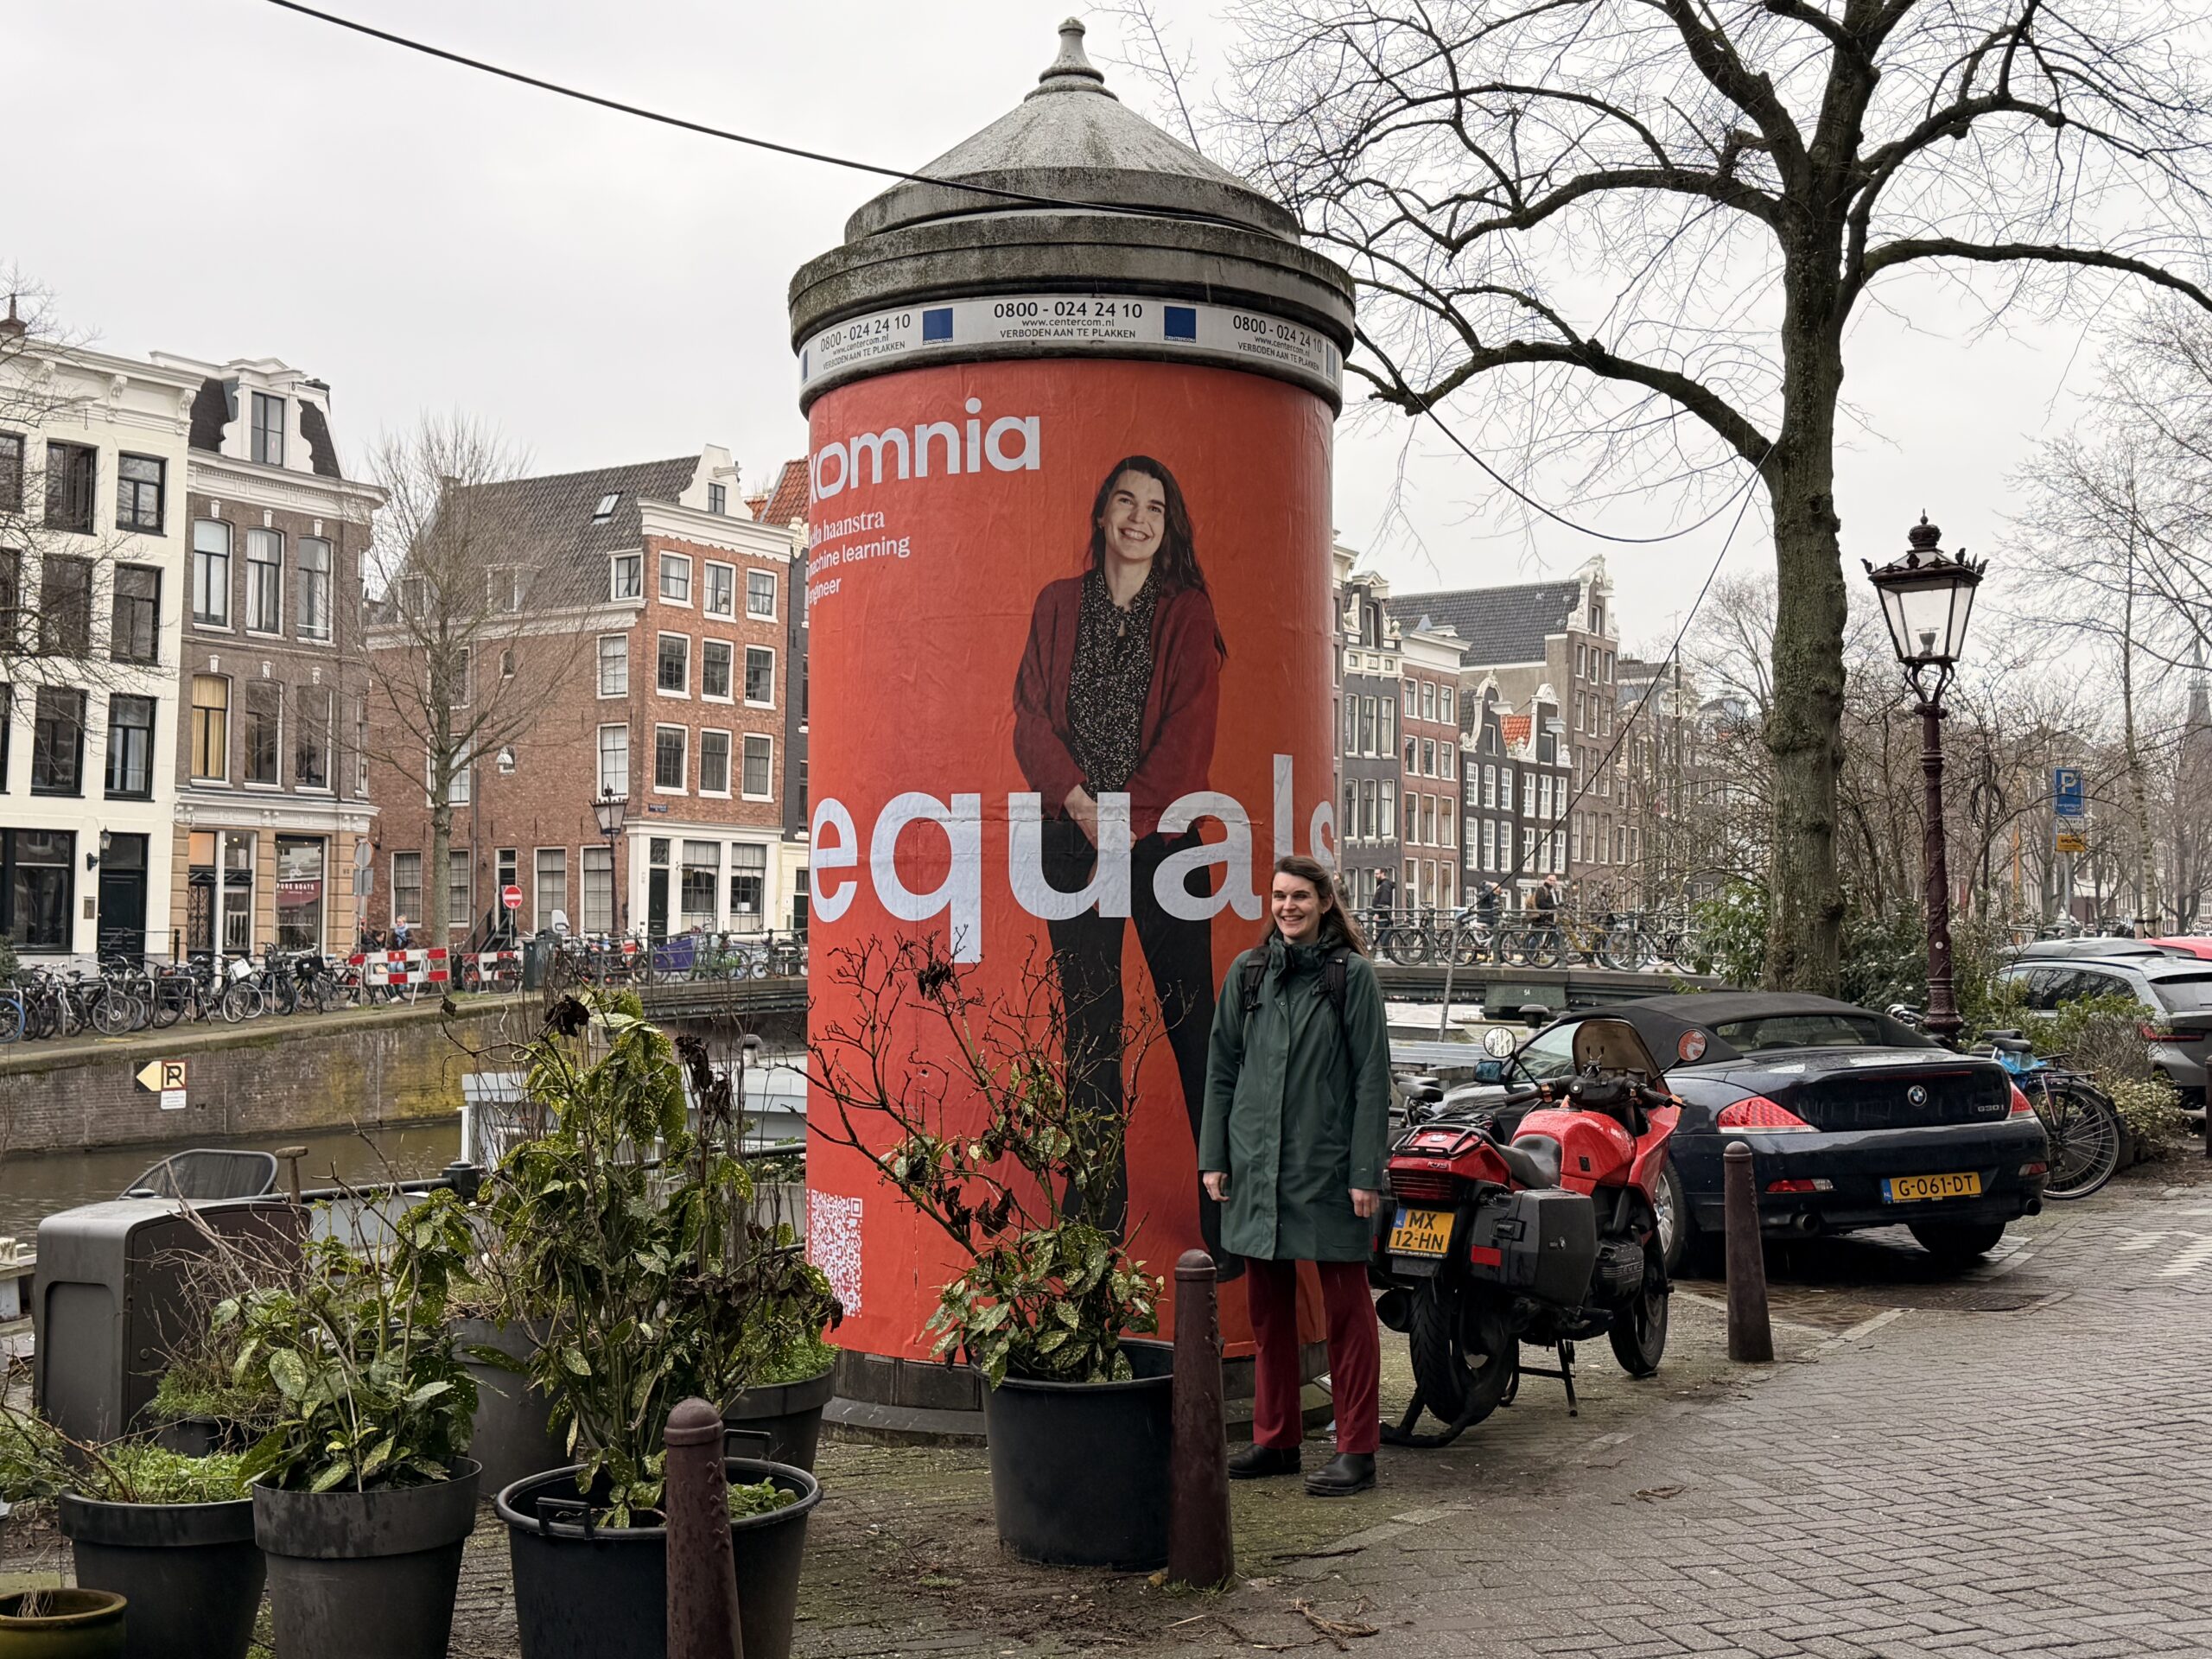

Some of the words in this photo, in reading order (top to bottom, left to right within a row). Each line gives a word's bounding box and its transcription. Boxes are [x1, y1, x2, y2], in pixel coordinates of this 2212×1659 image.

[994, 302, 1038, 318] 0800
[1054, 301, 1087, 316] 024
[1095, 302, 1116, 317] 24
[1122, 303, 1142, 318] 10
[821, 330, 842, 353] 0800
[849, 322, 870, 341] 024
[874, 317, 890, 334] 24
[894, 314, 911, 329] 10
[1000, 328, 1052, 339] VERBODEN
[1052, 327, 1074, 337] AAN
[1077, 327, 1089, 337] TE
[1091, 327, 1136, 339] PLAKKEN
[1021, 318, 1115, 327] www.centercom.nl
[1233, 315, 1267, 334] 0800
[1276, 324, 1296, 343] 024
[1300, 331, 1311, 348] 24
[1313, 337, 1322, 353] 10
[823, 353, 849, 371] VERBODEN
[849, 350, 861, 361] AAN
[864, 347, 871, 356] TE
[873, 340, 906, 355] PLAKKEN
[832, 333, 889, 356] www.centercom.nl
[1254, 335, 1311, 358] www.centercom.nl
[1237, 341, 1275, 357] VERBODEN
[1275, 351, 1289, 361] AAN
[1290, 353, 1298, 363] TE
[1298, 356, 1319, 372] PLAKKEN
[823, 511, 885, 543] haanstra
[842, 536, 910, 563] learning
[2061, 772, 2077, 794] P
[1898, 1175, 1973, 1197] G-061-DT
[1408, 1211, 1437, 1230] MX
[1395, 1230, 1445, 1250] 12-HN
